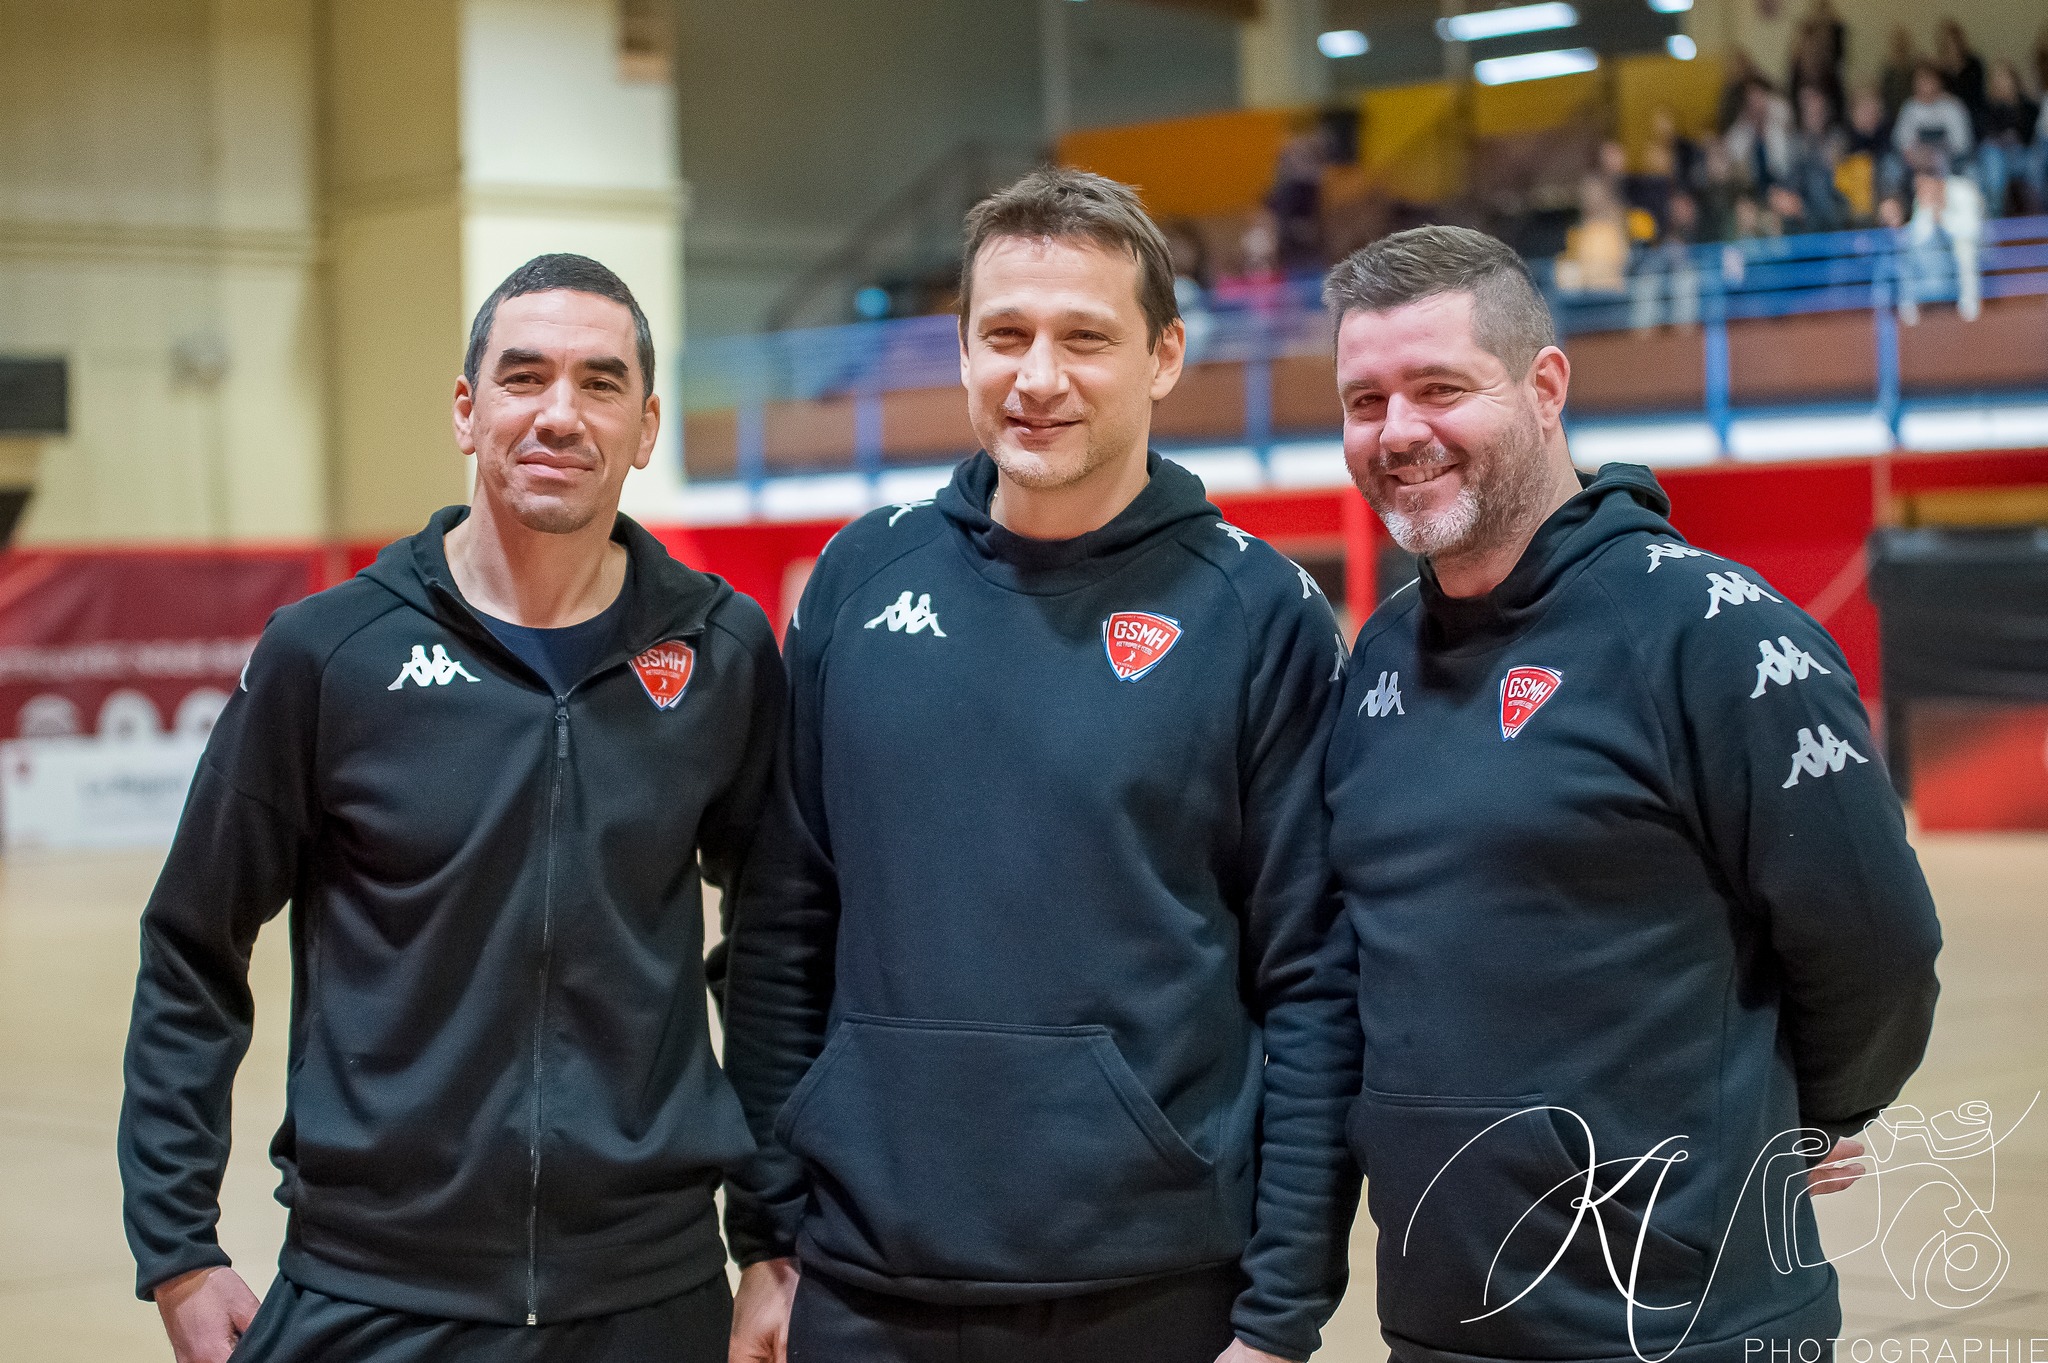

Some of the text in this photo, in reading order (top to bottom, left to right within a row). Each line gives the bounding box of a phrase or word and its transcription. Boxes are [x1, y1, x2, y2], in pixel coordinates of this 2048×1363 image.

[1113, 620, 1171, 650] GSMH
[636, 648, 687, 673] GSMH
[1507, 677, 1553, 704] GSMH
